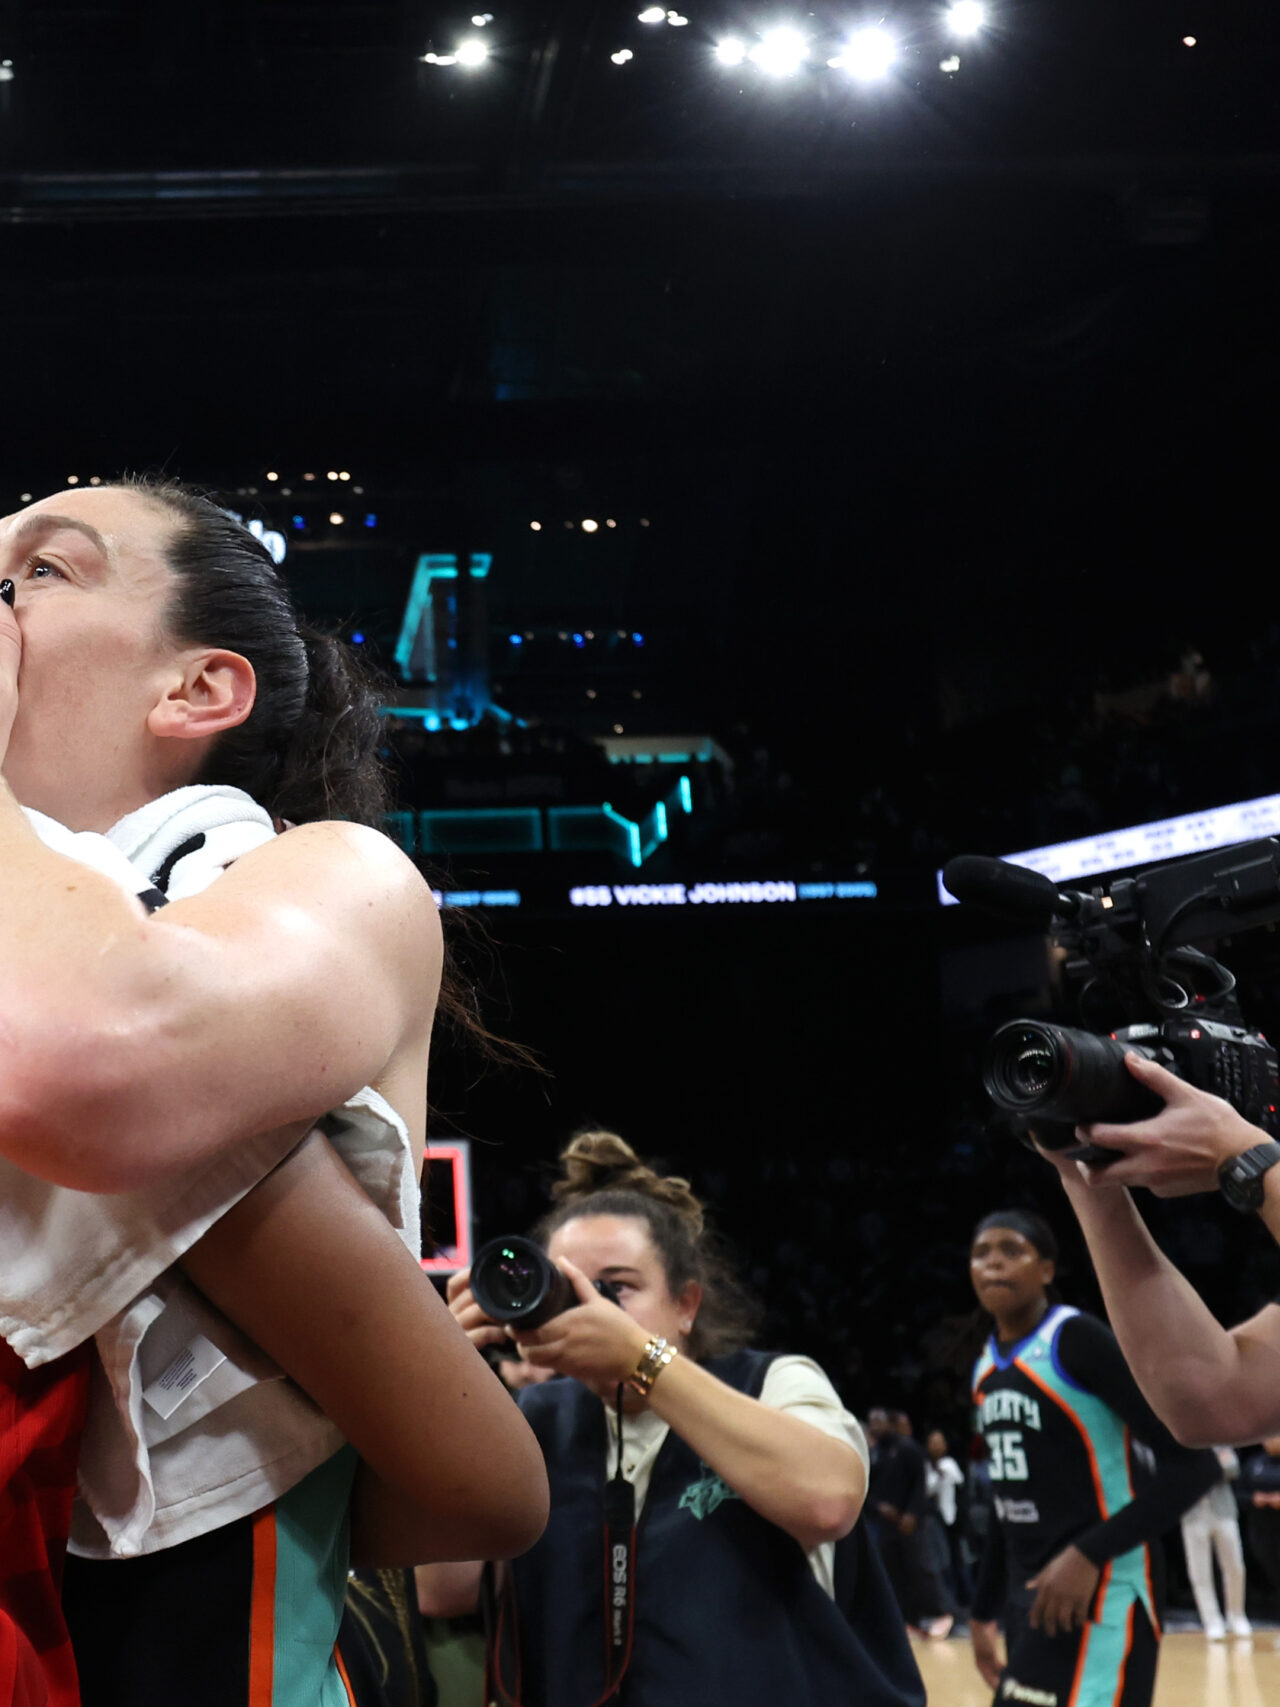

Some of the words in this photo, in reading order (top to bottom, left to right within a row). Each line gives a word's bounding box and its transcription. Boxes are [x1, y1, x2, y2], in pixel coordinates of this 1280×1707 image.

[614, 883, 687, 905] VICKIE
[688, 881, 797, 904] JOHNSON
[985, 1430, 1029, 1481] 35
[612, 1544, 628, 1584] EOS
[612, 1585, 627, 1607] R6
